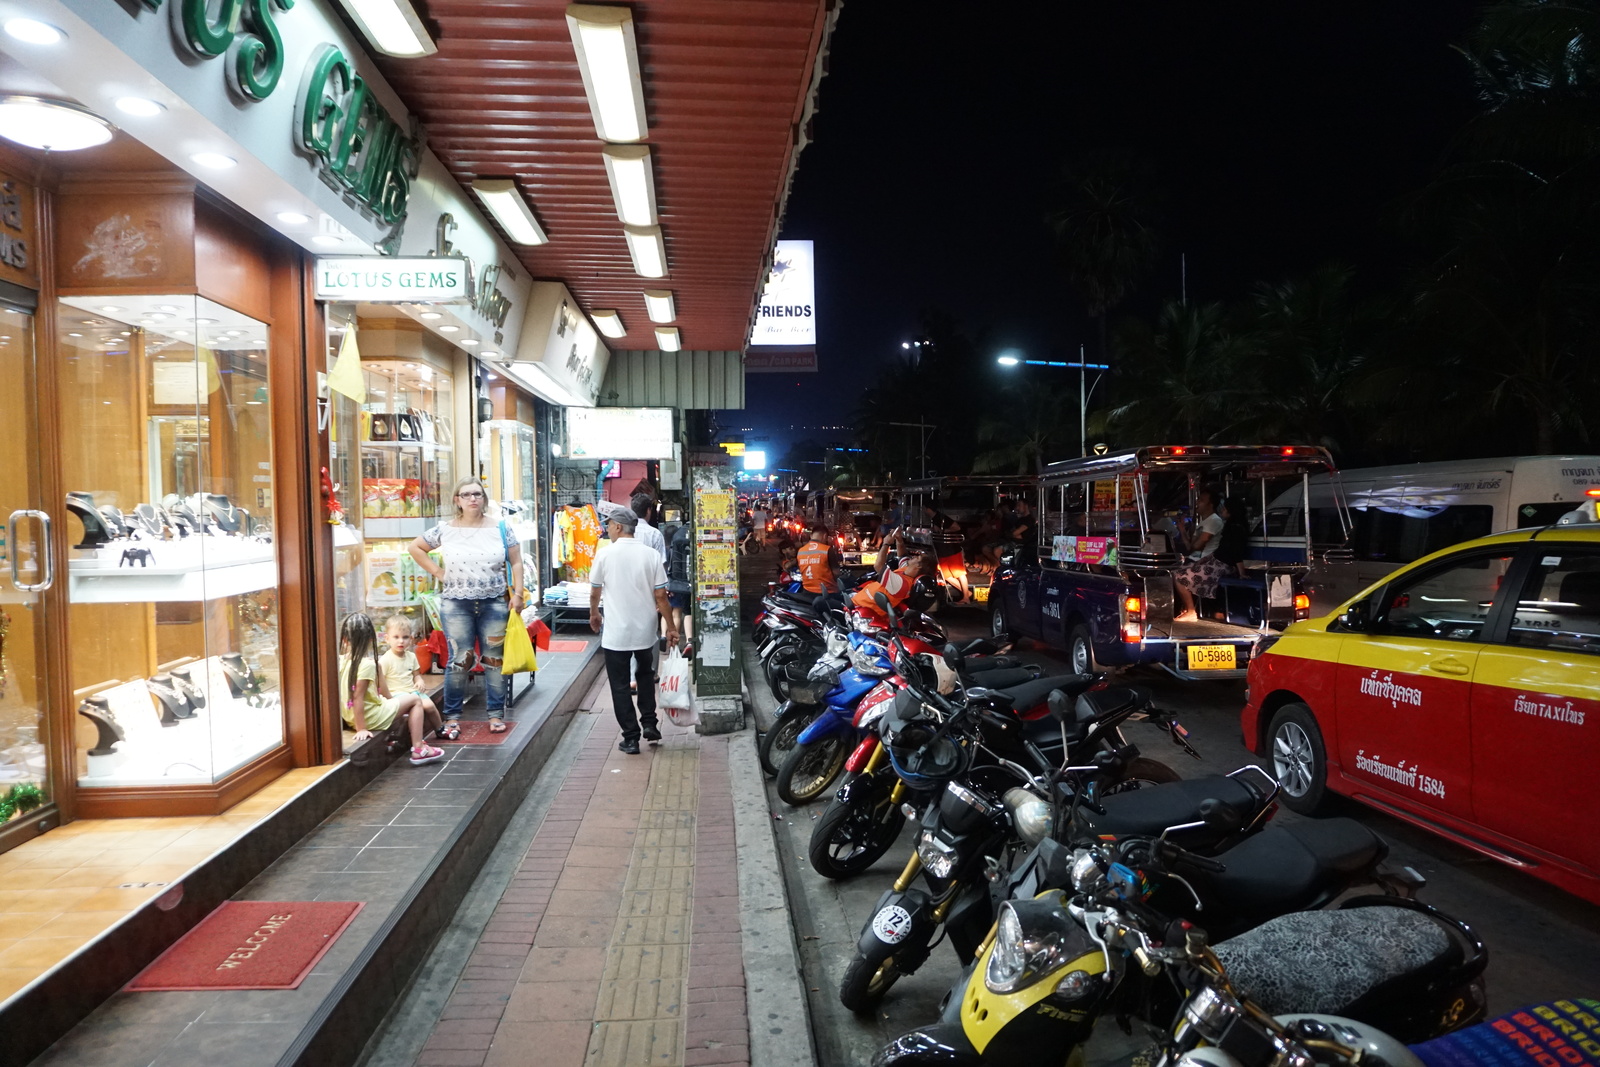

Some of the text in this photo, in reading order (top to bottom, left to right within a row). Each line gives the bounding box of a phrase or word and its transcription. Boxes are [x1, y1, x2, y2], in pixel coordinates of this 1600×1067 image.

[324, 271, 457, 288] LOTUS GEMS
[756, 304, 812, 317] FRIENDS
[805, 565, 814, 580] 4
[1192, 650, 1233, 662] 10-5988
[1418, 773, 1446, 800] 1584
[215, 912, 293, 971] WELCOME
